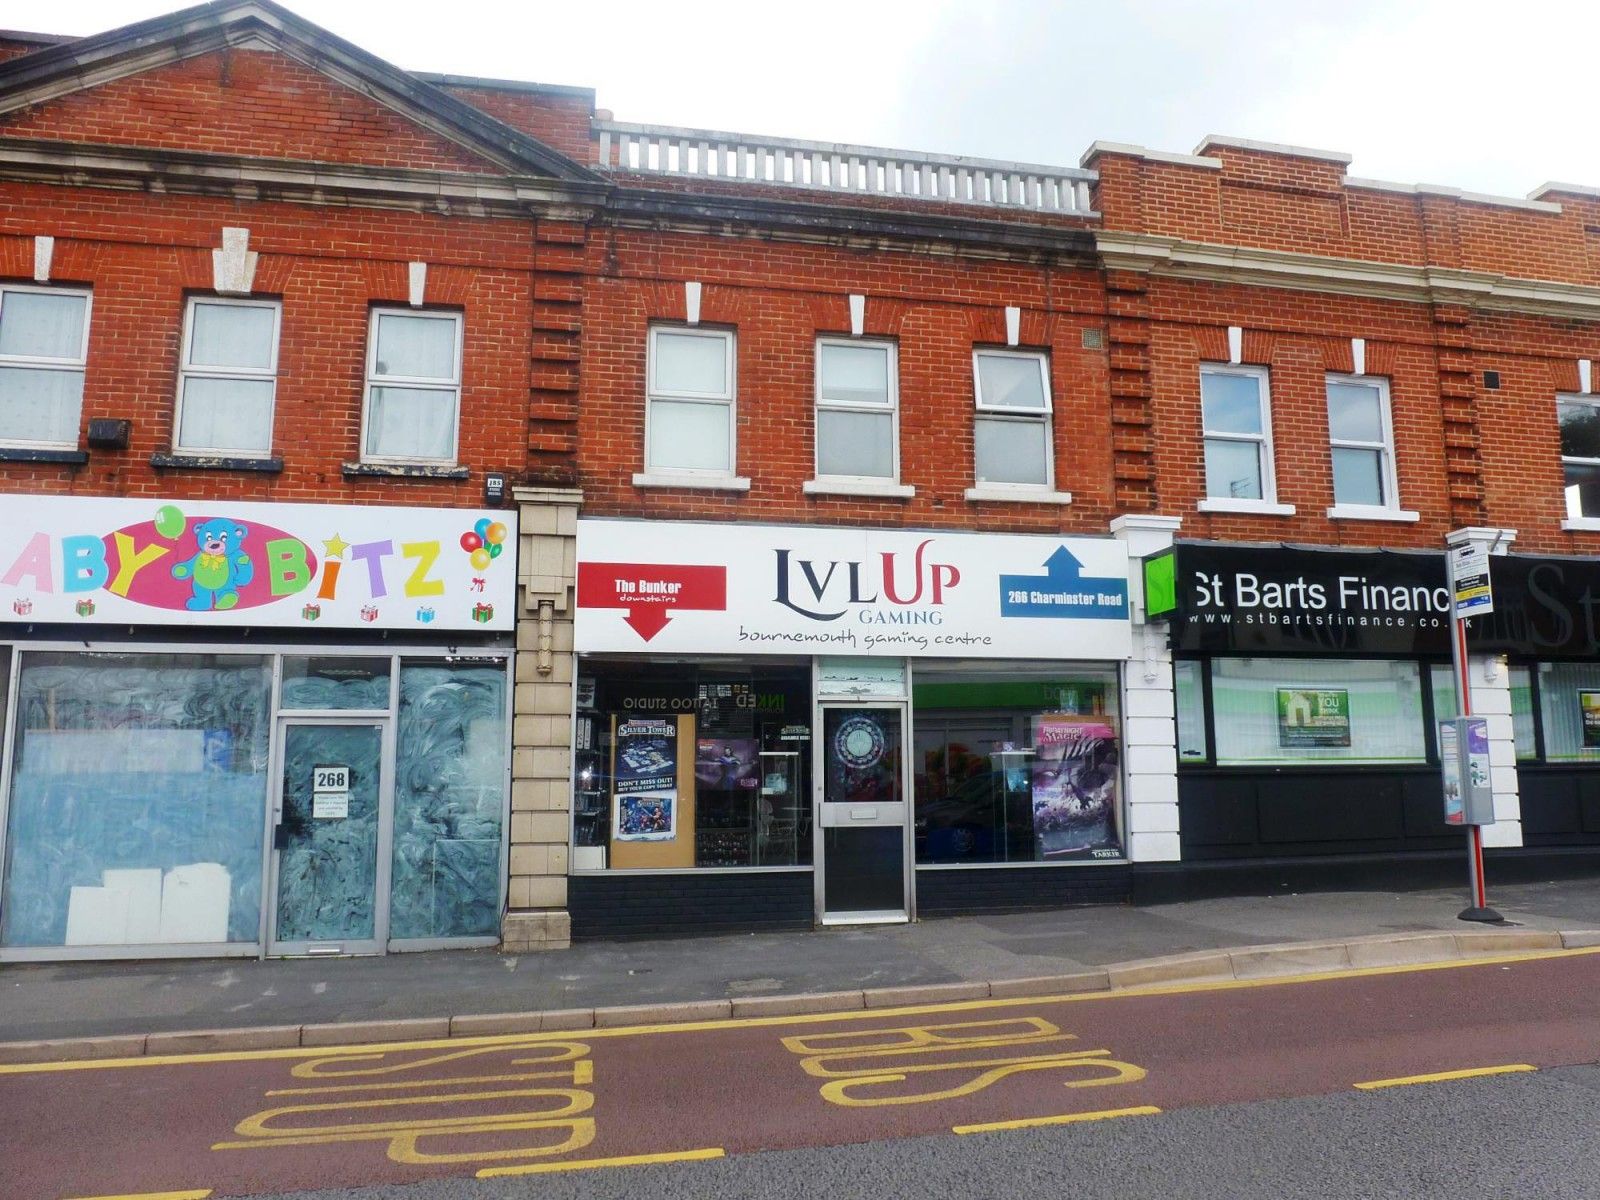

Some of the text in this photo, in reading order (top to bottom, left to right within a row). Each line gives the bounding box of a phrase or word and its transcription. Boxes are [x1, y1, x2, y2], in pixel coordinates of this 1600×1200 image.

[615, 579, 682, 594] The Bunker
[1235, 573, 1327, 610] Barts
[1338, 576, 1450, 612] Financ
[619, 593, 677, 603] downstairs
[1030, 591, 1095, 606] Charminster
[1097, 593, 1122, 606] Road
[859, 609, 943, 625] GAMING
[1189, 612, 1473, 629] www.stbartsfinance.co.k
[739, 625, 992, 650] bournemouth gaming centre
[318, 772, 345, 787] 268
[780, 1017, 1148, 1107] BUS
[211, 1042, 597, 1164] STOP
